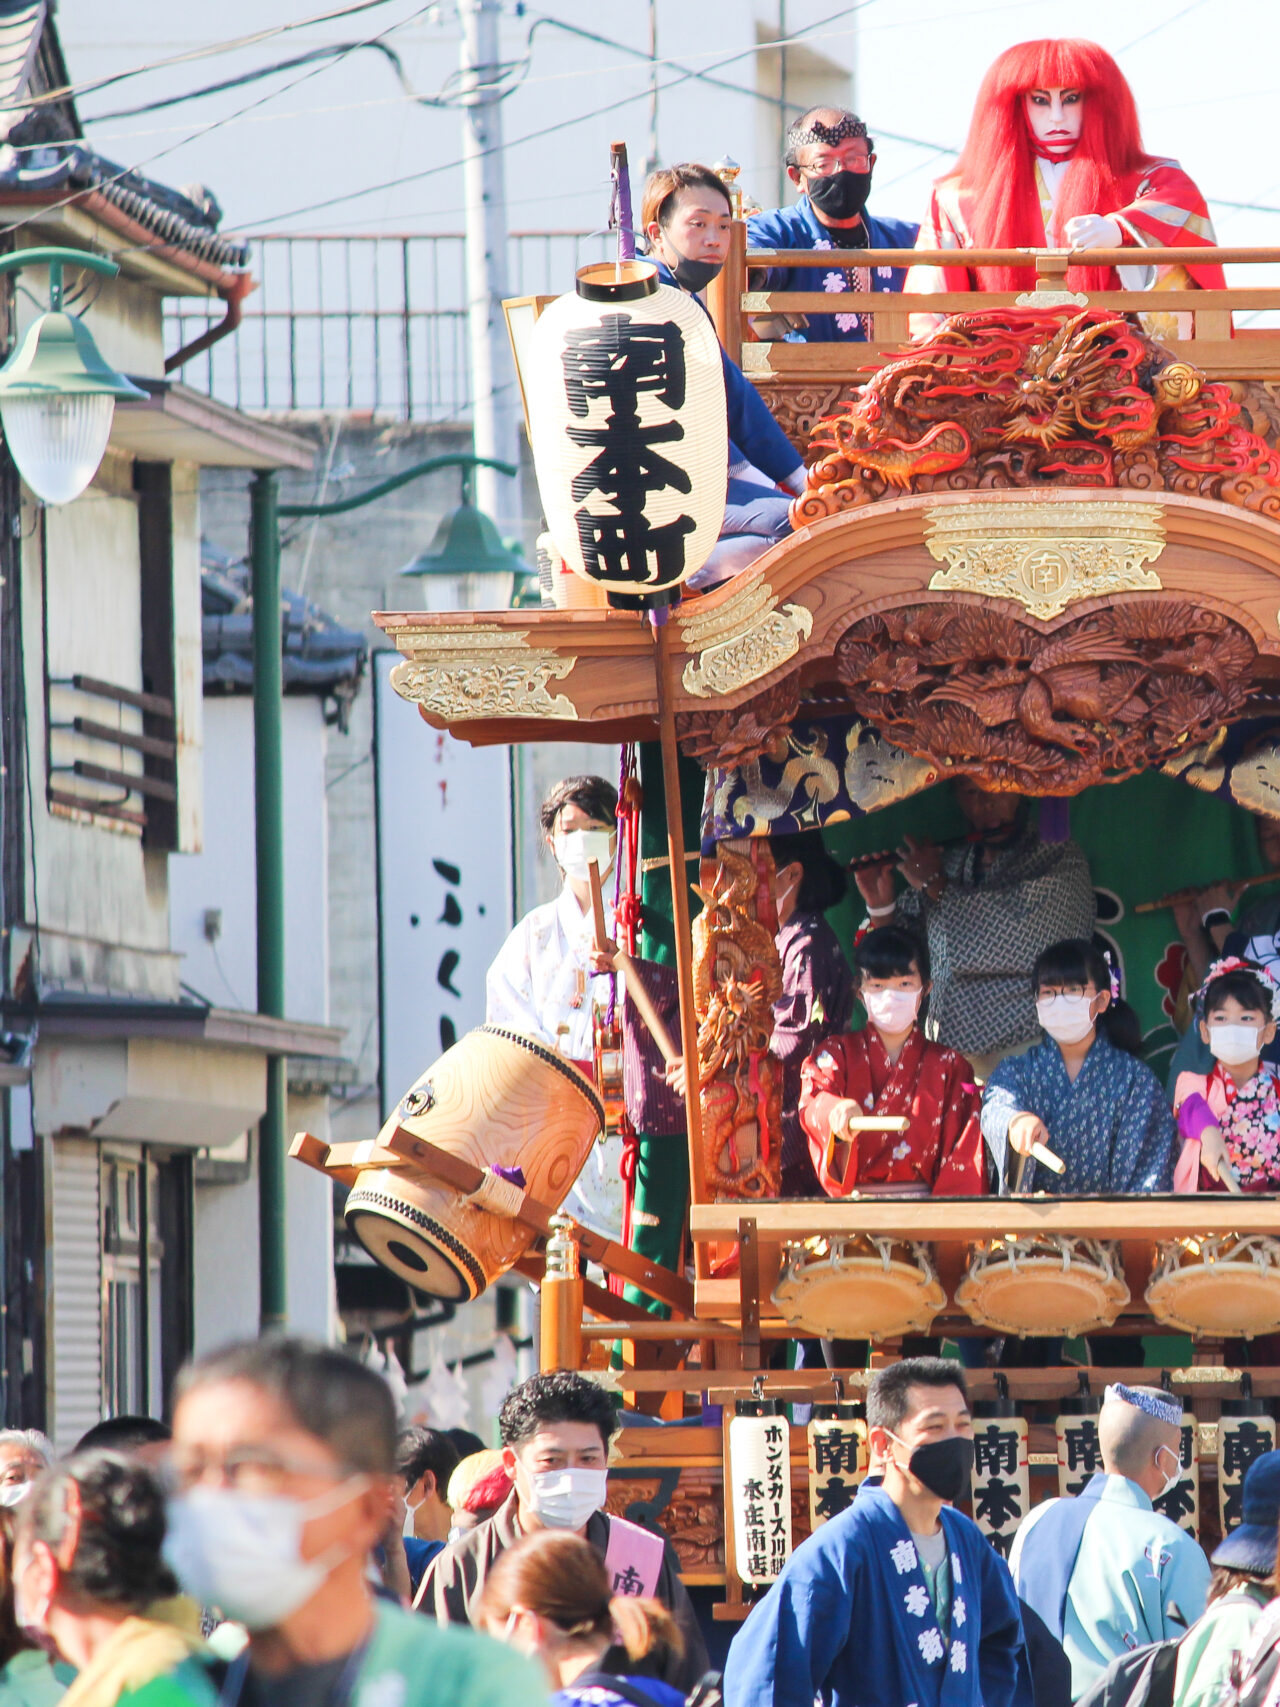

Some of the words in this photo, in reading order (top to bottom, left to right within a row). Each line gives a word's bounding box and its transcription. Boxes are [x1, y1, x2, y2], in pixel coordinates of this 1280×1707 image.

[561, 313, 697, 586] 南本町
[1030, 551, 1062, 594] 南
[1064, 1420, 1106, 1497] 南
[743, 1478, 768, 1577] 本庄南店
[613, 1565, 645, 1596] 南
